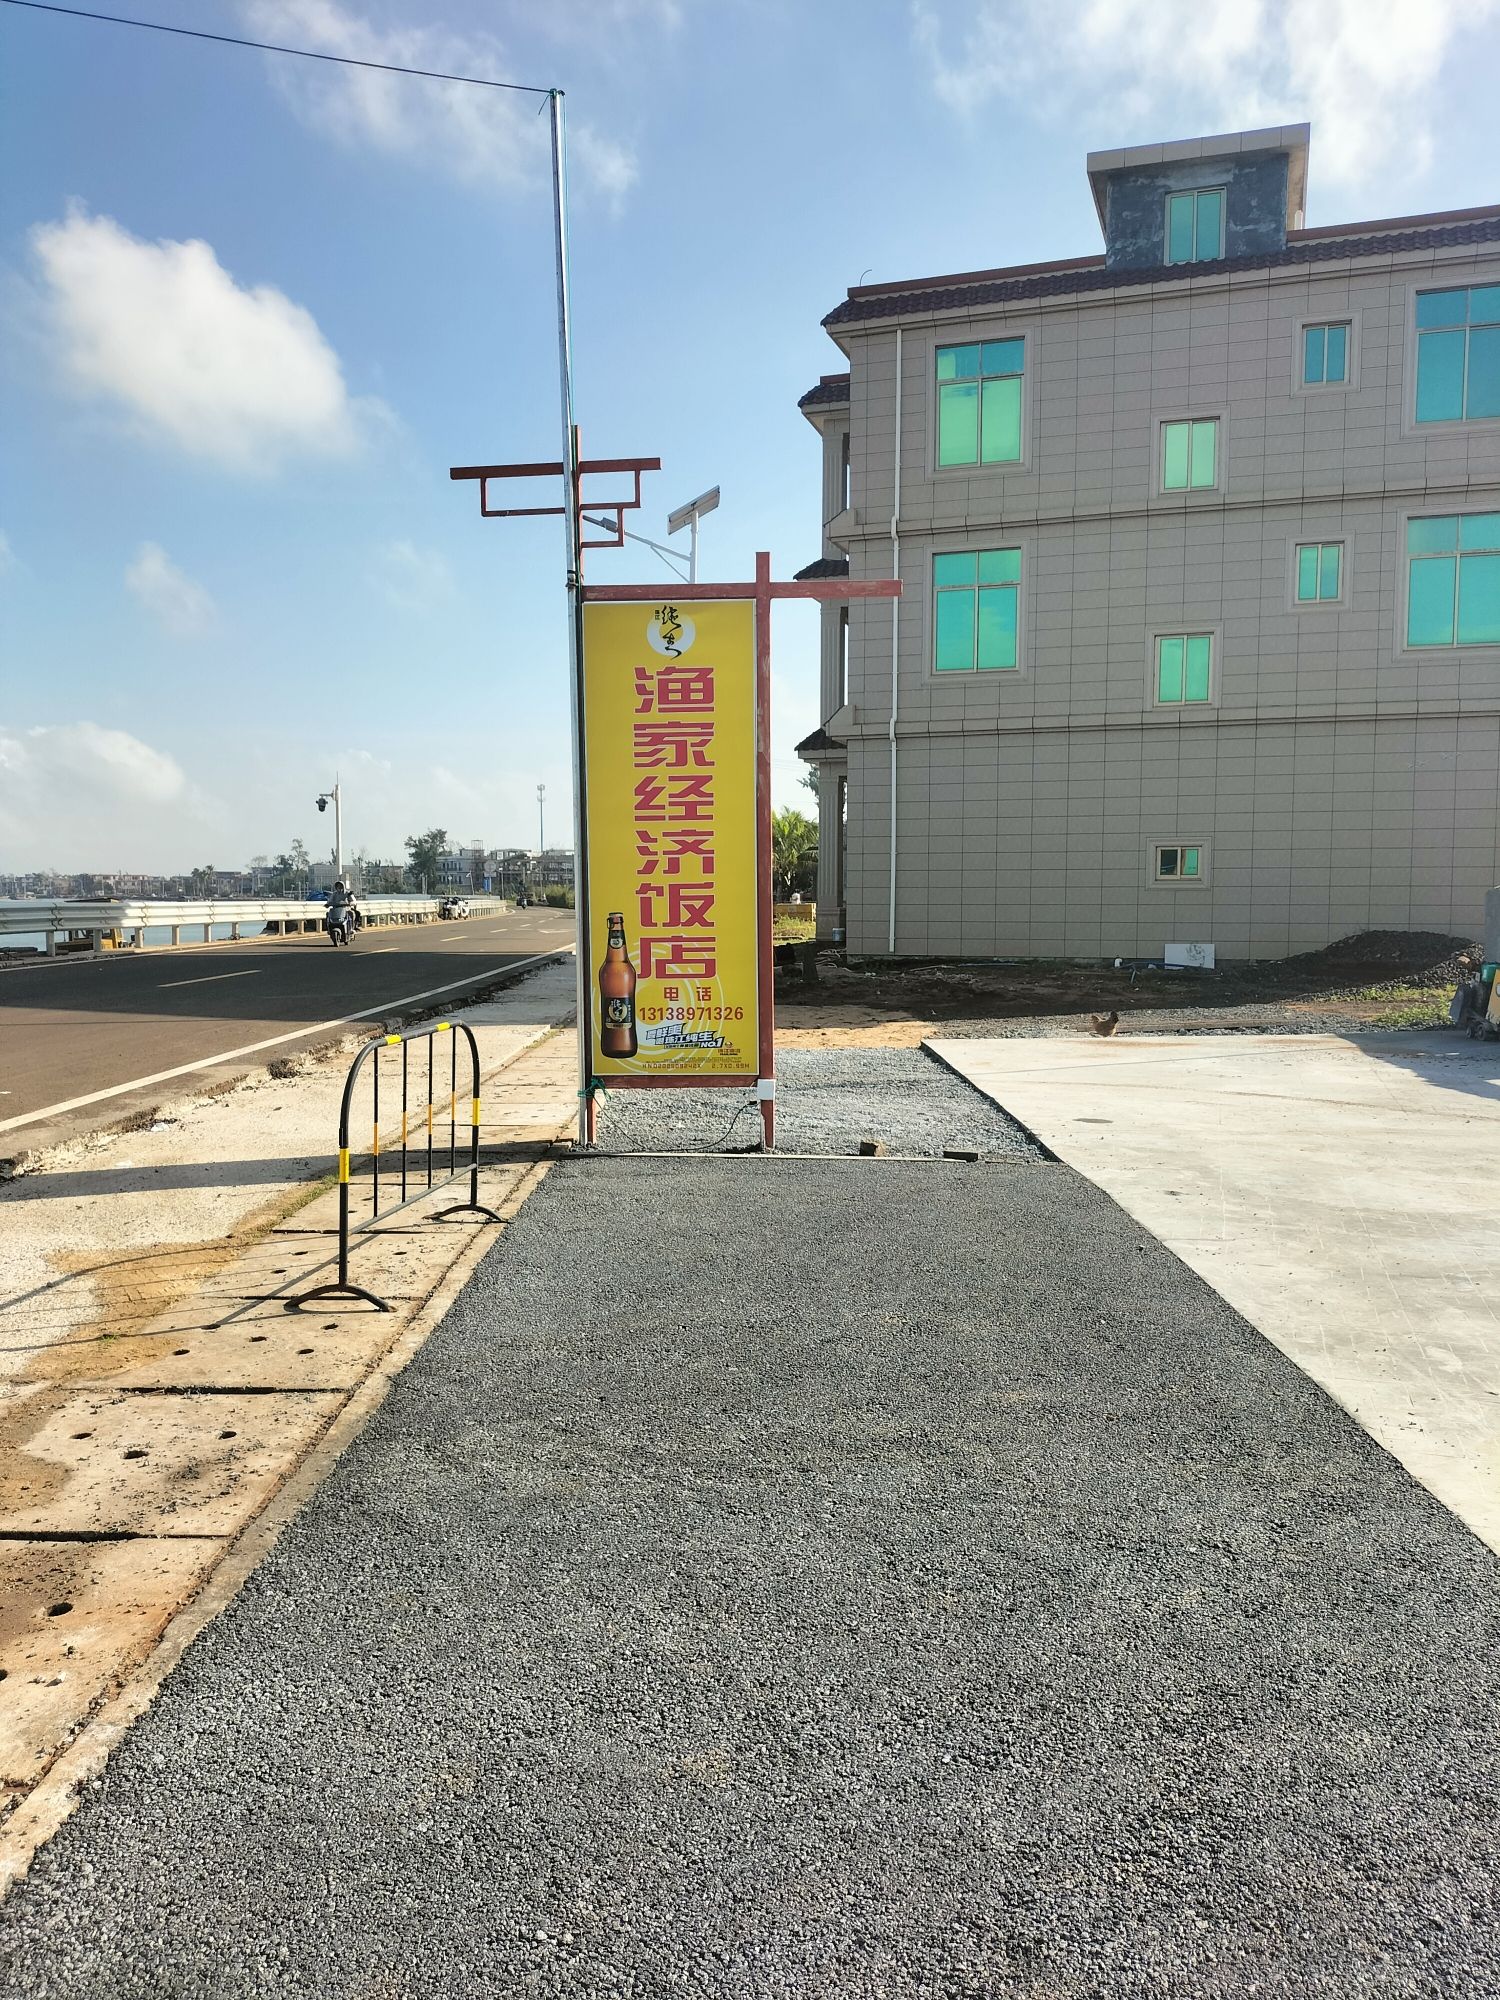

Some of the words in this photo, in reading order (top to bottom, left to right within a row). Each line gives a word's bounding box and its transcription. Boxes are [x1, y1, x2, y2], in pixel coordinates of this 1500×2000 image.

[633, 665, 716, 980] 渔家经济饭店
[664, 986, 712, 1001] 电话
[639, 1006, 744, 1021] 13138971326
